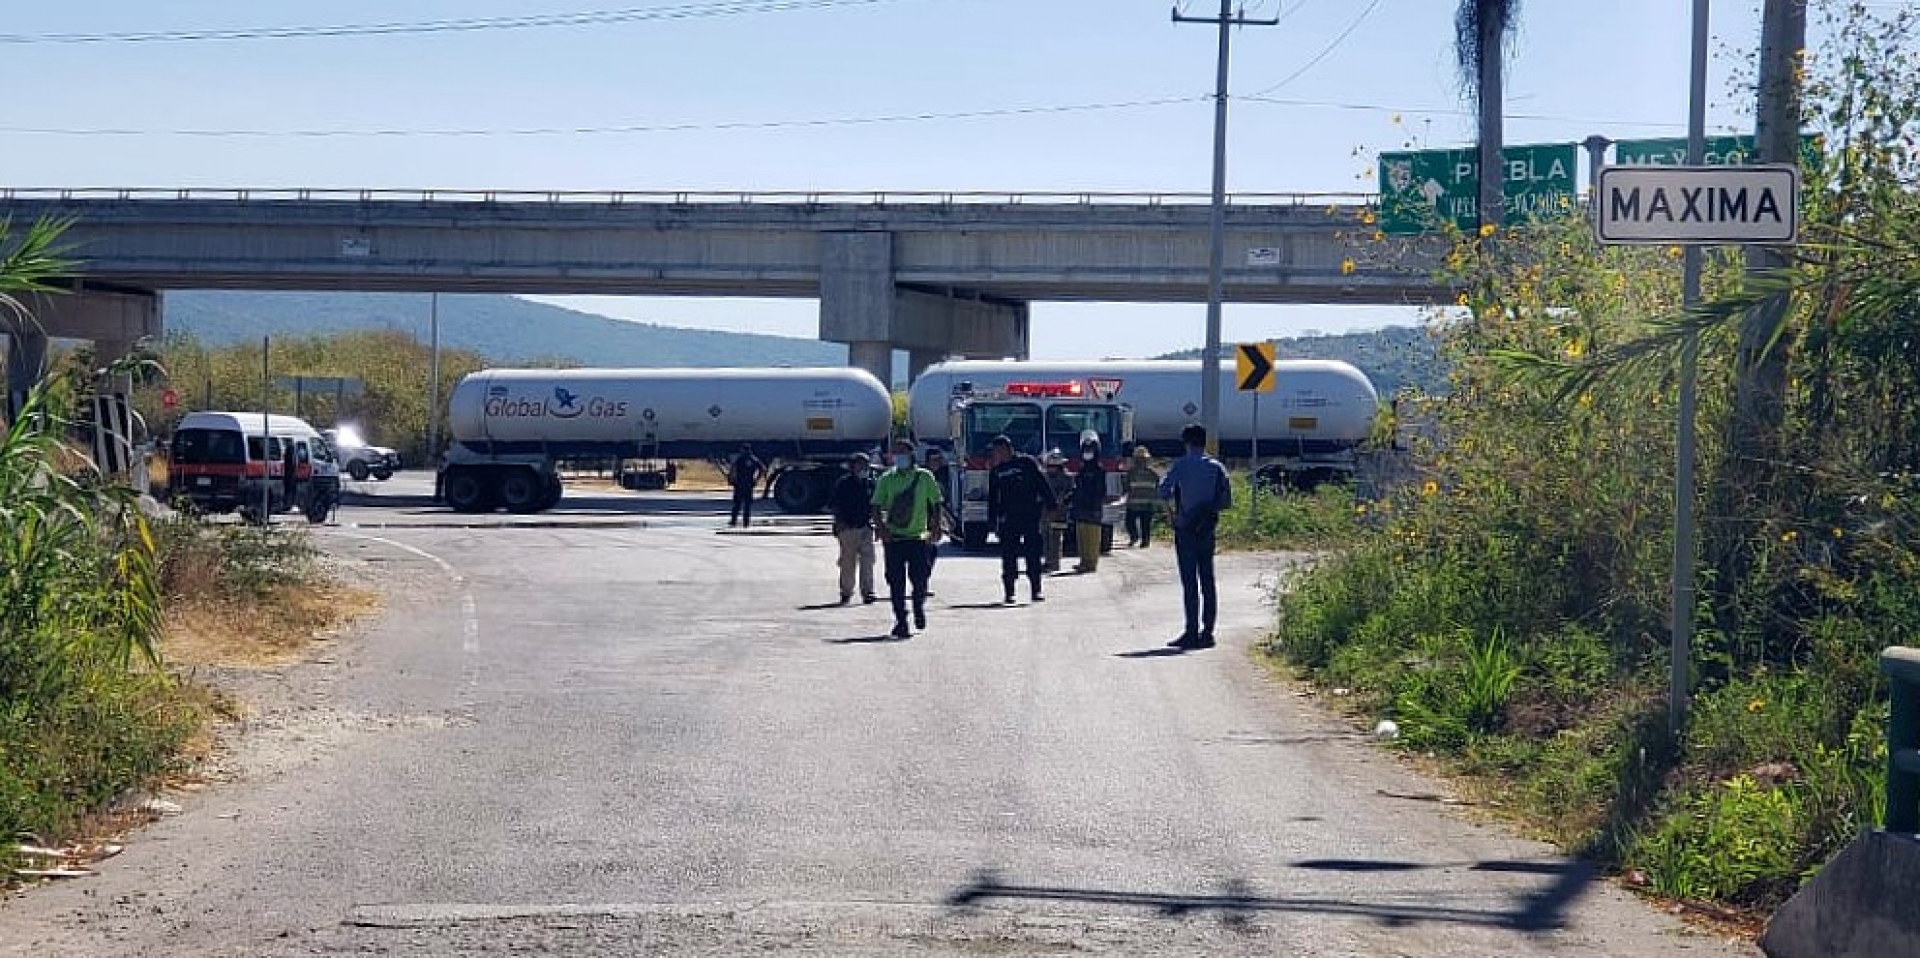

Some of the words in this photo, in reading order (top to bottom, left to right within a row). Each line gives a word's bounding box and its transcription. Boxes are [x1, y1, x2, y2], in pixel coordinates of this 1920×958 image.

[1455, 158, 1567, 184] PBLA
[1611, 187, 1782, 223] MAXIMA
[485, 396, 549, 417] Global
[588, 396, 628, 417] Gas
